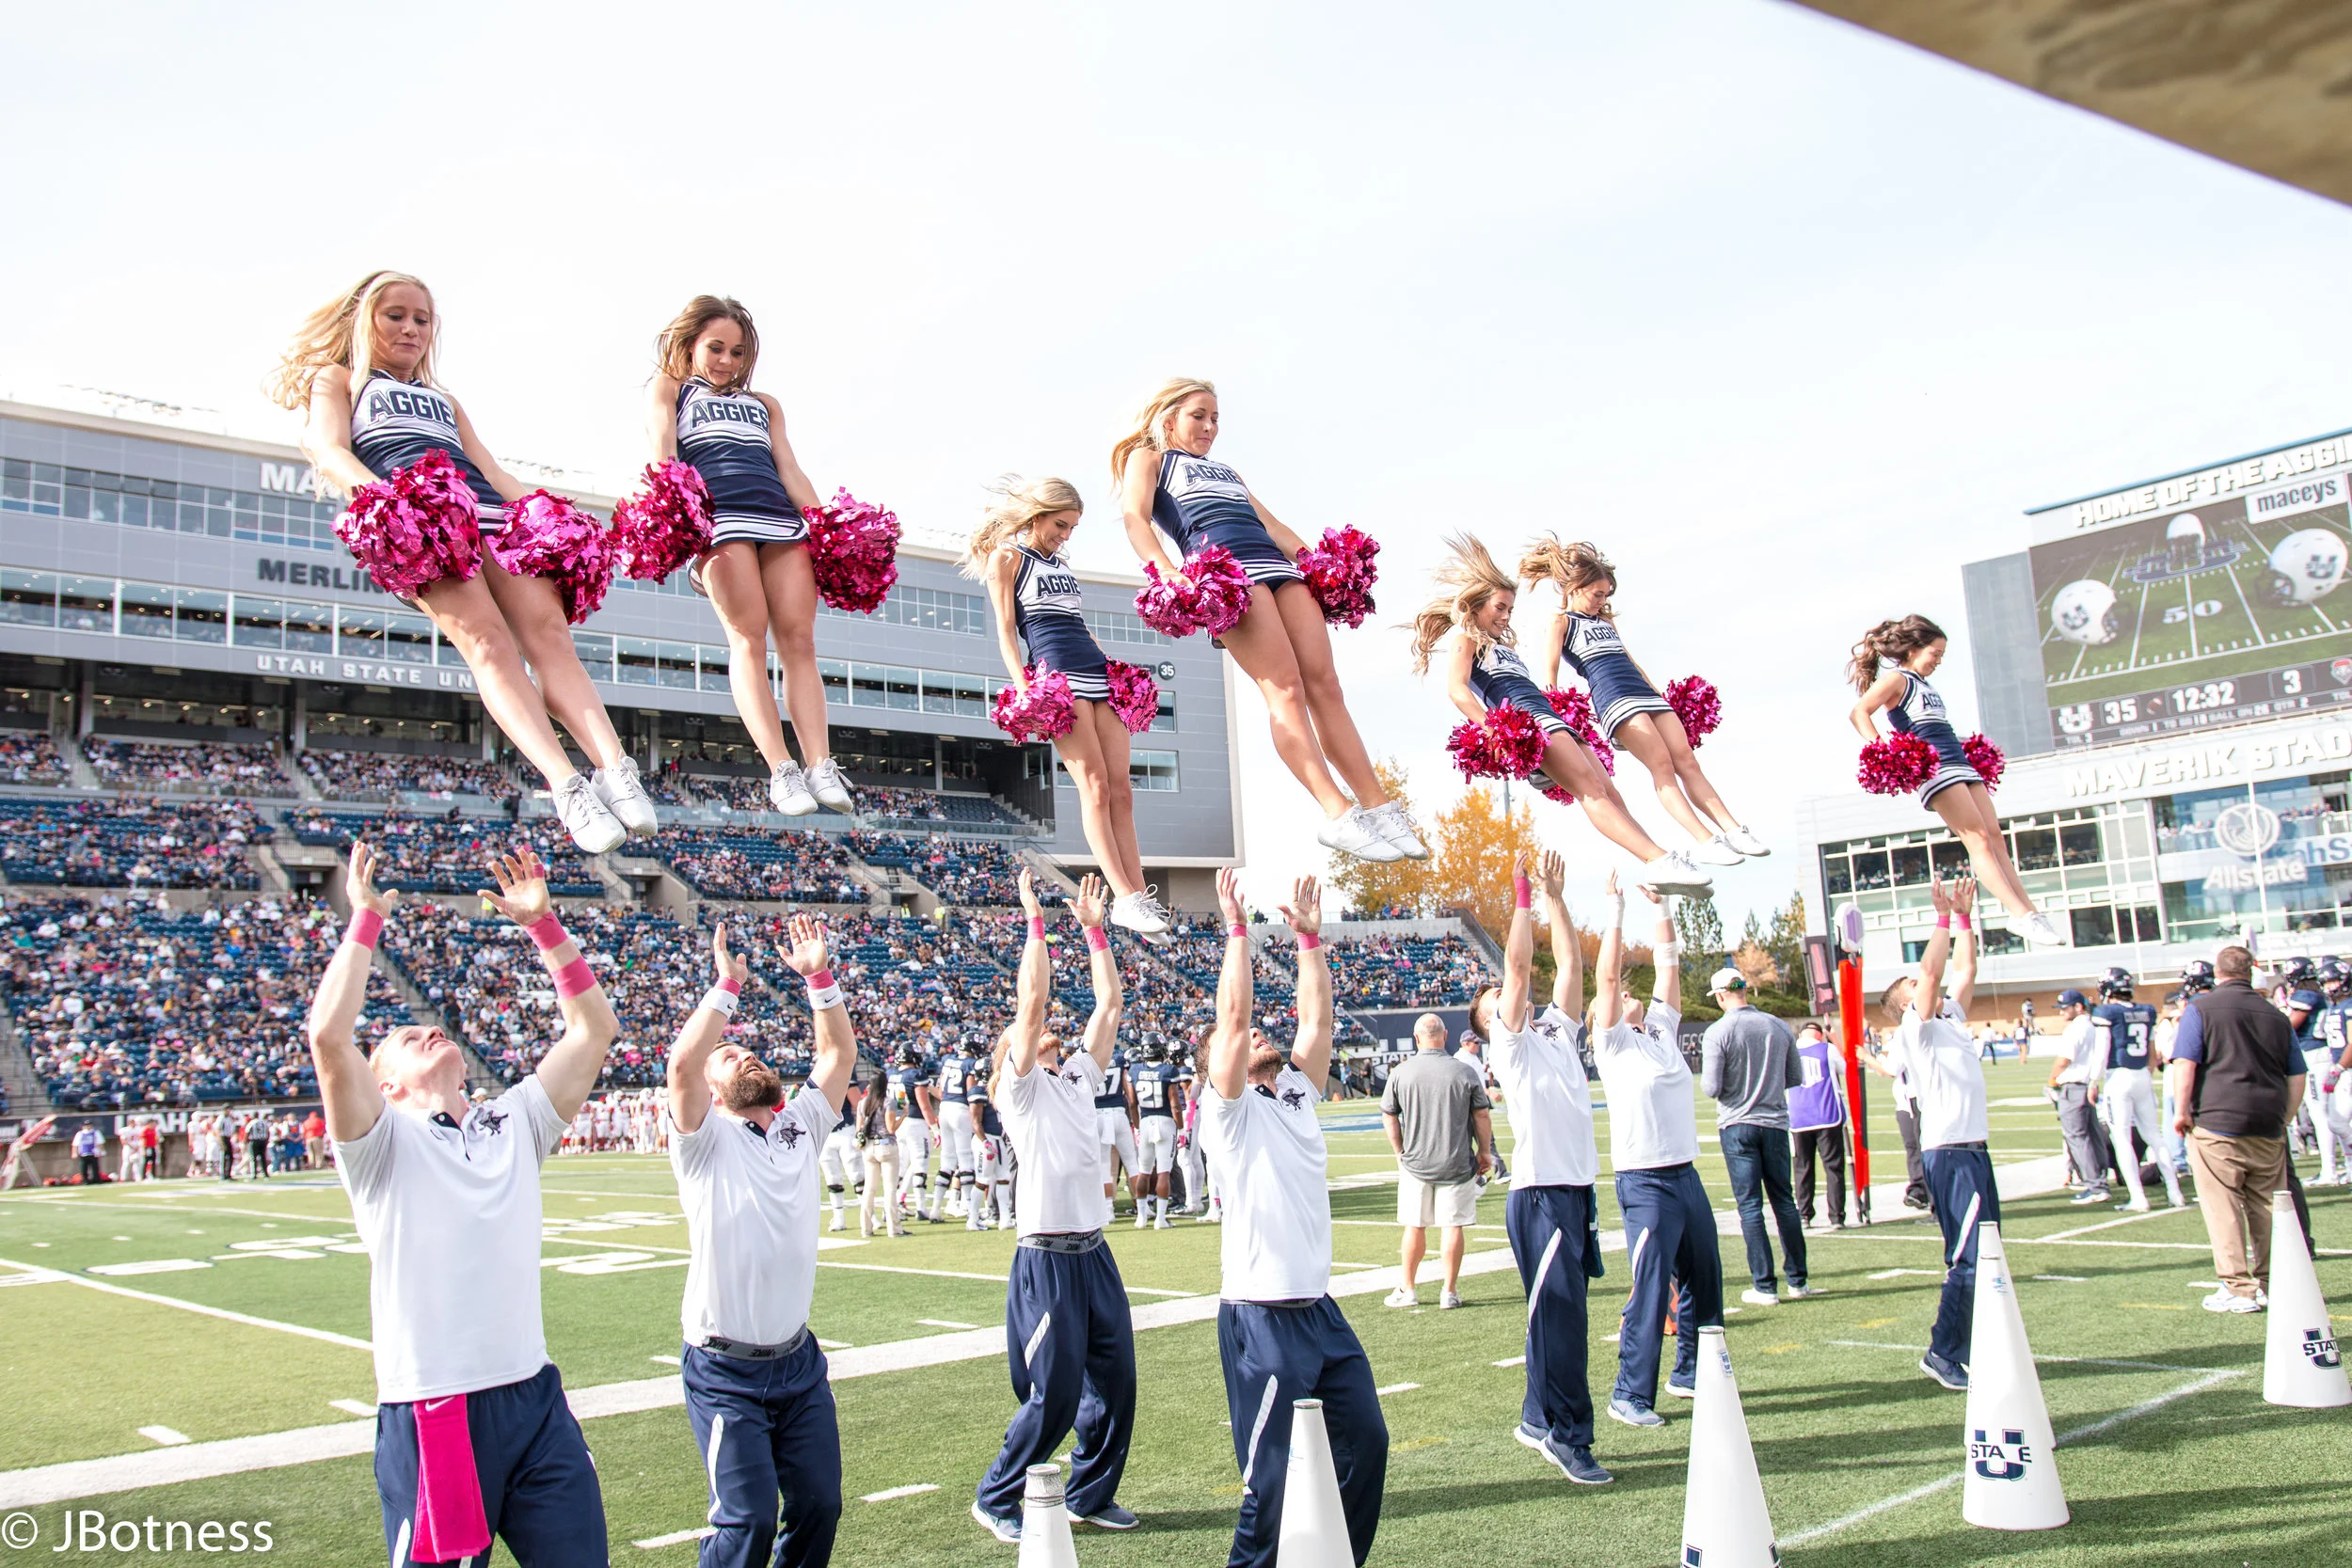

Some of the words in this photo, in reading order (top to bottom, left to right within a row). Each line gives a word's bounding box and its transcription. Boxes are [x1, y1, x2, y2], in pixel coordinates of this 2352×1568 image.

[2074, 486, 2159, 528] HOME
[2164, 473, 2199, 506] OF
[2200, 456, 2265, 496] THE
[2258, 480, 2337, 513] maceys
[257, 654, 325, 675] UTAH
[342, 662, 422, 685] STATE
[1161, 664, 1174, 676] 35
[2104, 698, 2138, 725] 35
[2171, 680, 2236, 713] 12:32
[2282, 669, 2302, 694] 3
[2069, 746, 2239, 798] MAVERIK
[2126, 1022, 2148, 1057] 3
[1136, 1080, 1164, 1109] 21
[749, 1348, 775, 1357] NIKE
